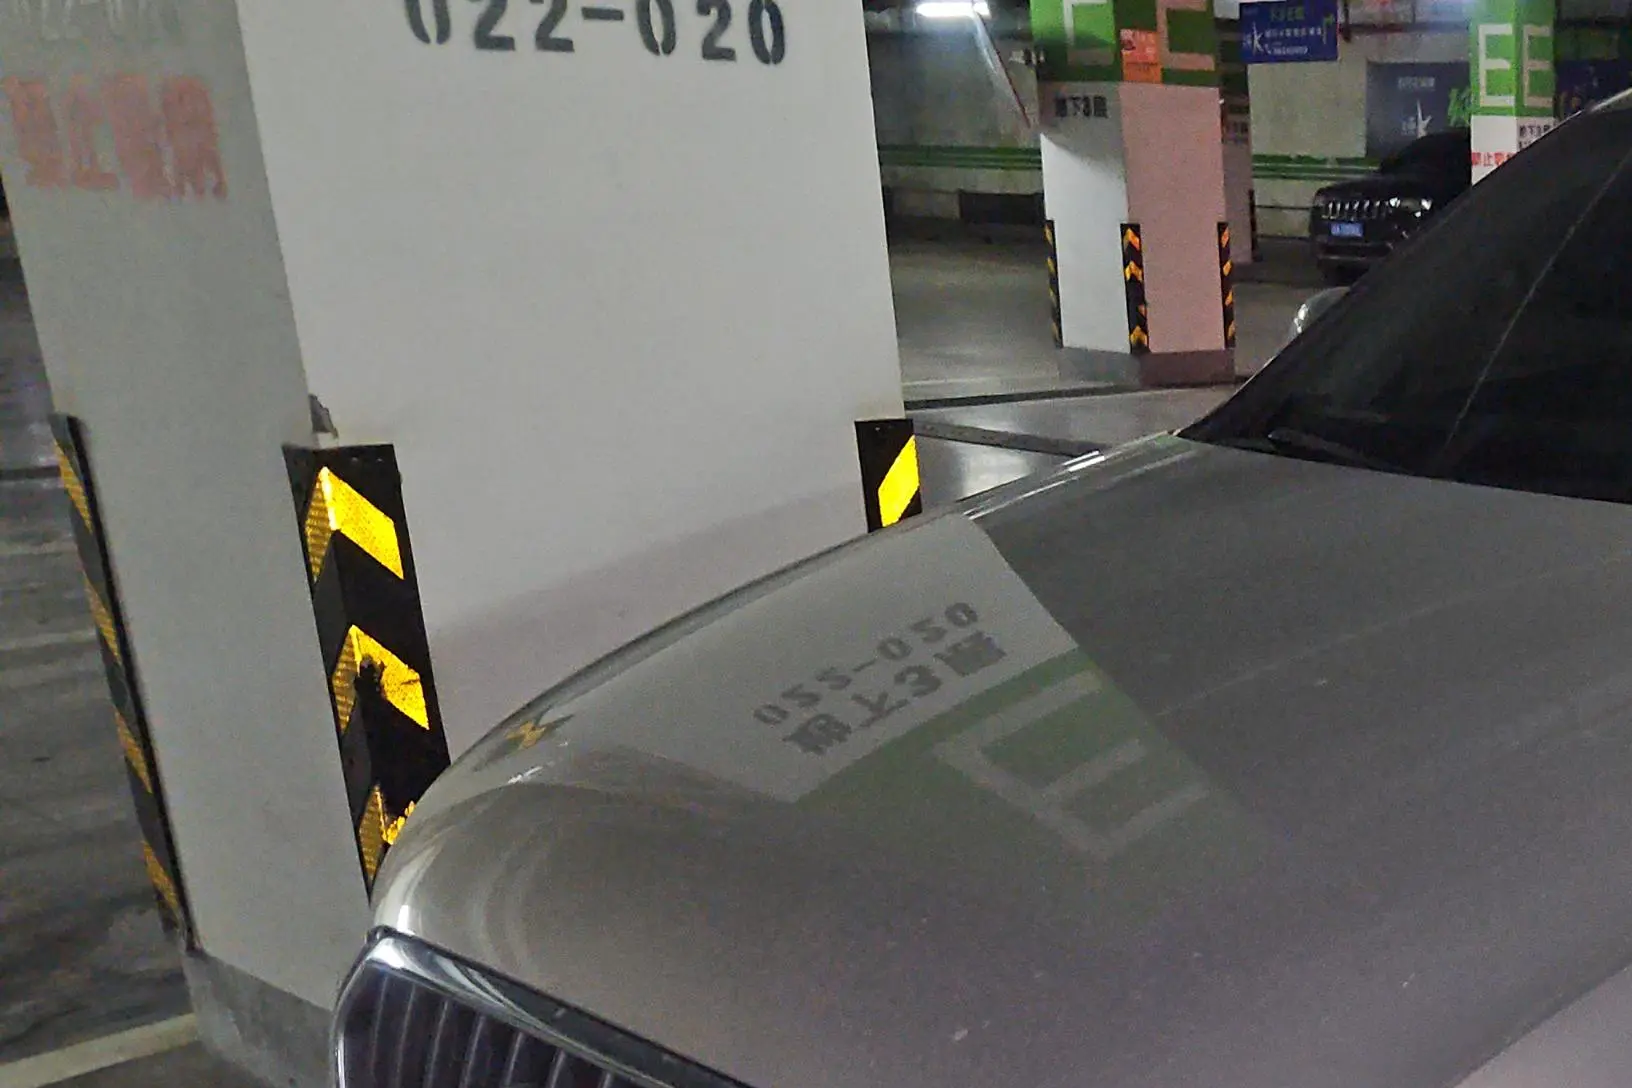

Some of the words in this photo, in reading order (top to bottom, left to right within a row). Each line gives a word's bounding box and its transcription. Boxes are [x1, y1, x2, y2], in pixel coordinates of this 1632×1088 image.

[404, 0, 786, 65] 022-020
[1478, 23, 1515, 107] E
[1523, 25, 1553, 107] E
